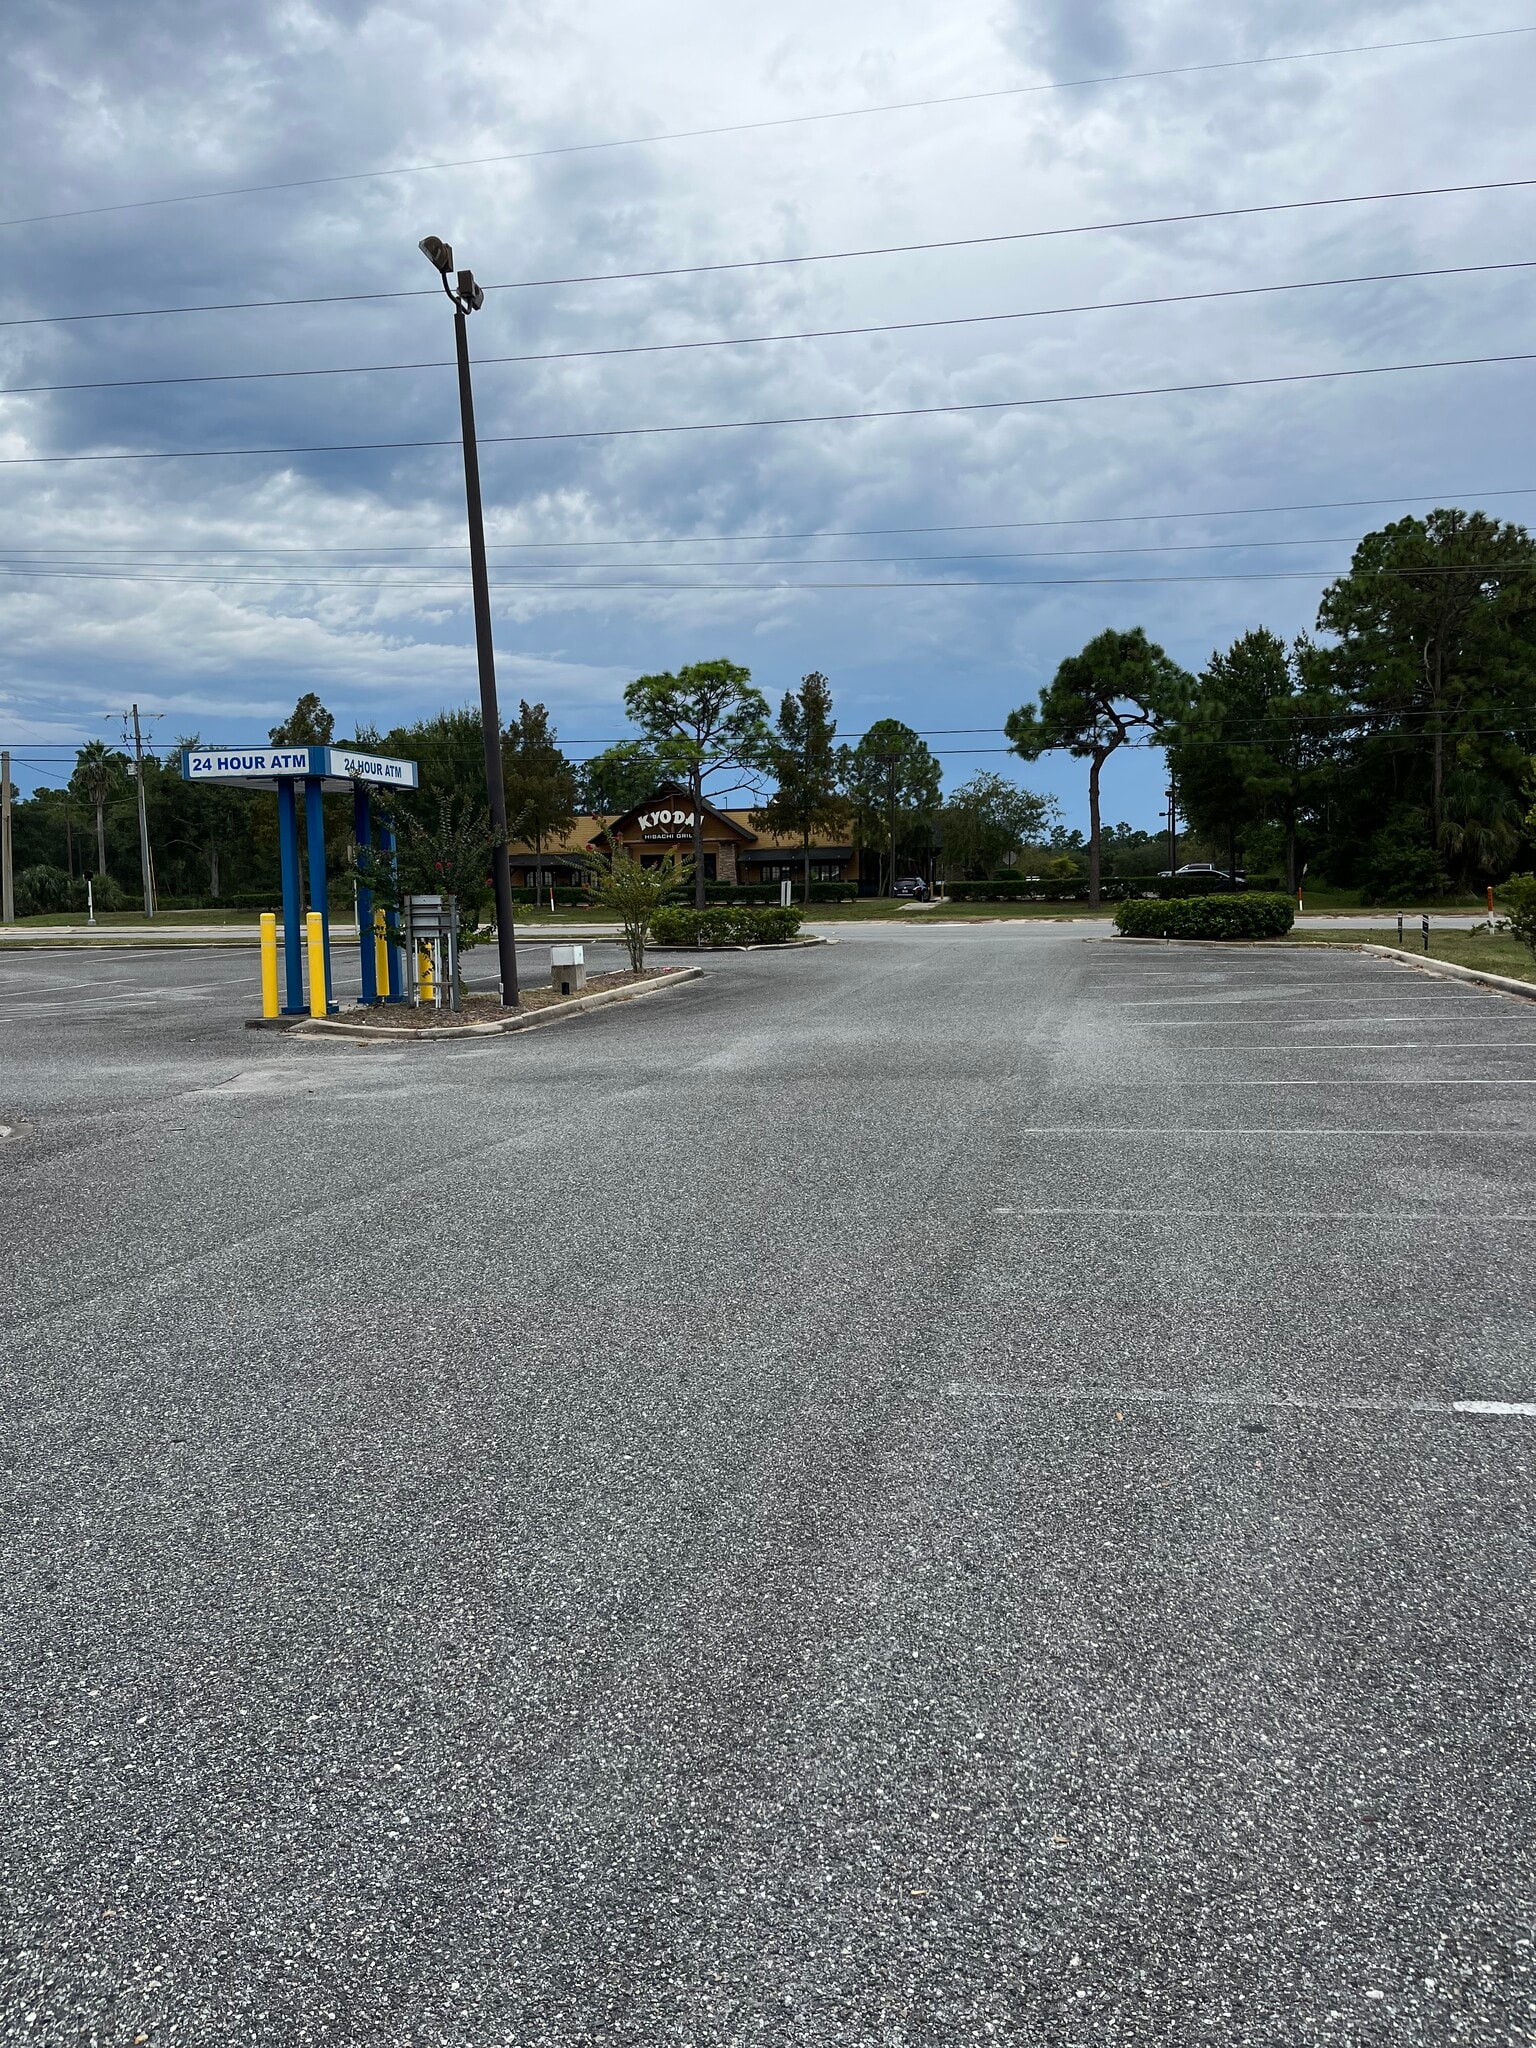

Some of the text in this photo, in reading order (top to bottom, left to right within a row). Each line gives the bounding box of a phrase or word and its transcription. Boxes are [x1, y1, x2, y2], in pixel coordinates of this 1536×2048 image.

[192, 755, 306, 771] 24 HOUR ATM
[344, 758, 402, 778] 24 HOUR ATM
